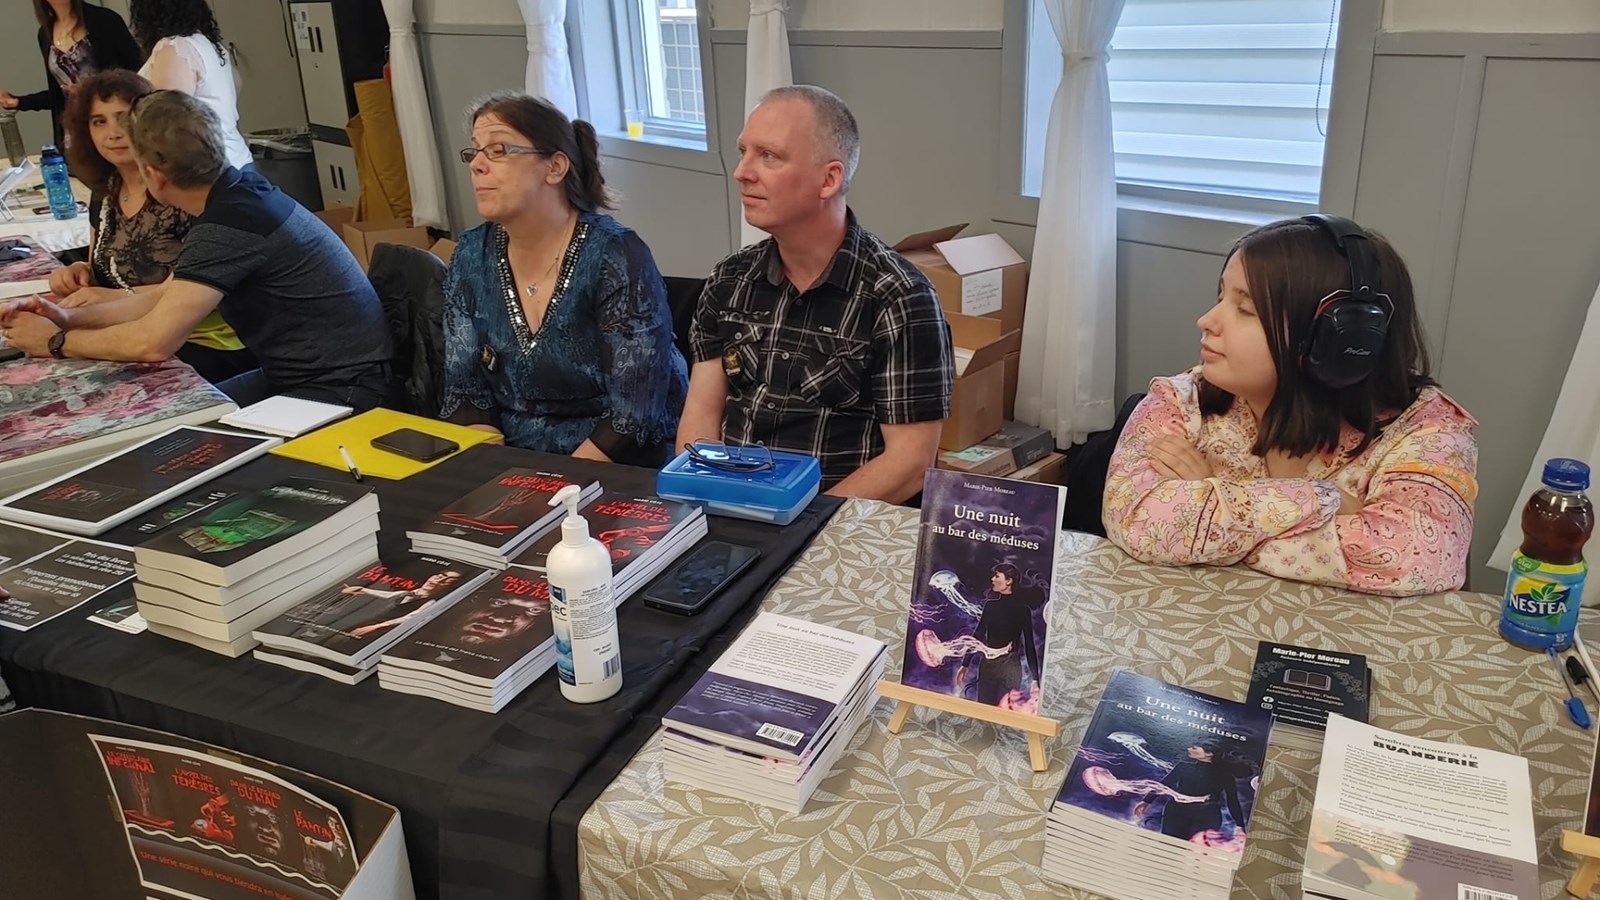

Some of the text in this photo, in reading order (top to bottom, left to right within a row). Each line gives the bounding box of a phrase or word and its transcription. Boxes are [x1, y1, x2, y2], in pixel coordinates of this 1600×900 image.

[499, 477, 561, 493] INFERNA
[954, 504, 1021, 528] Une nuit
[932, 525, 1039, 550] au bar des méduses
[356, 572, 419, 590] PANTIN
[503, 583, 529, 595] DU
[1509, 593, 1567, 615] NESTEA
[1272, 647, 1350, 665] Marie-Pier Moreau
[1117, 702, 1247, 742] au bar des méduses
[1145, 696, 1226, 725] Une nuit
[1373, 740, 1479, 769] BUANDERIE
[1374, 734, 1411, 748] Sombres
[1413, 744, 1460, 757] rencontres
[296, 817, 333, 840] PANTIN
[140, 851, 157, 861] Une
[158, 855, 177, 867] série
[200, 867, 214, 878] qui
[215, 871, 233, 883] vous
[234, 877, 262, 893] tiendra
